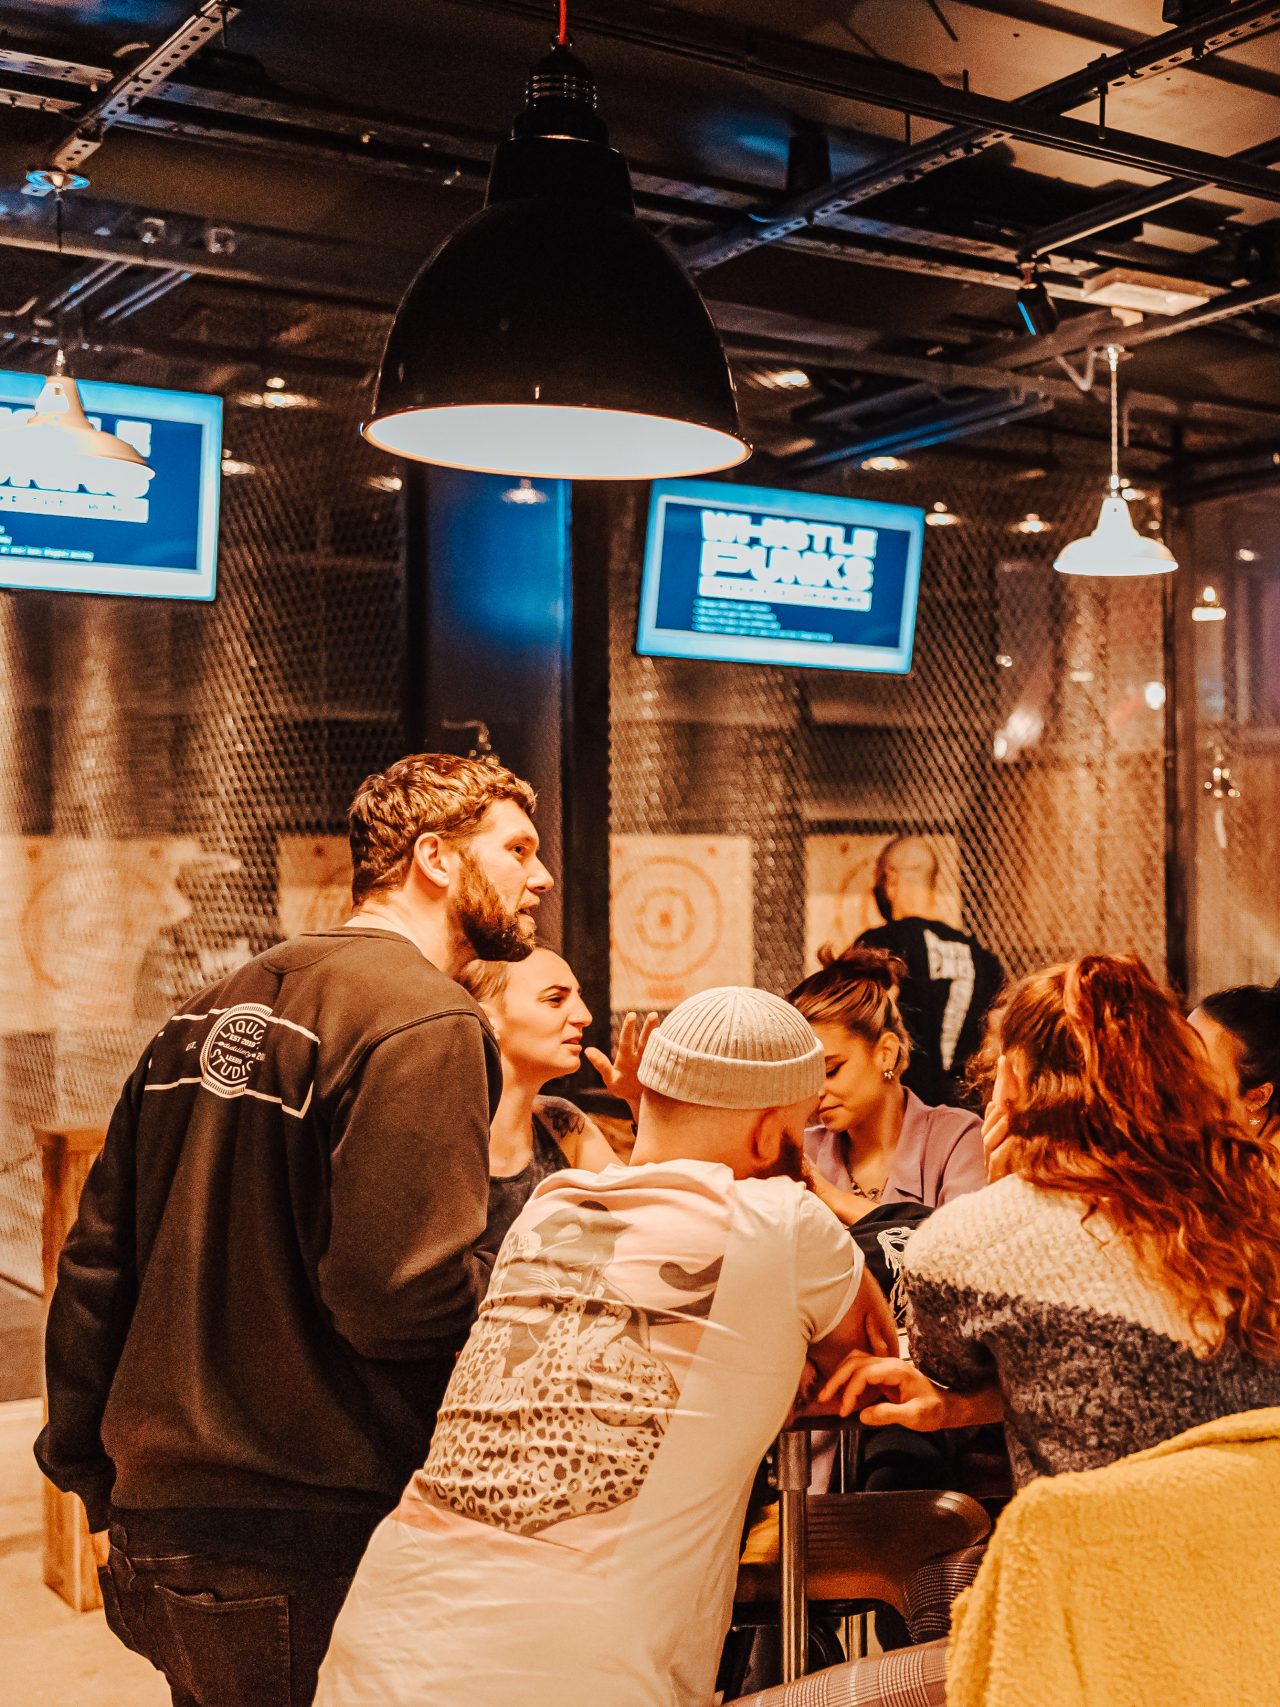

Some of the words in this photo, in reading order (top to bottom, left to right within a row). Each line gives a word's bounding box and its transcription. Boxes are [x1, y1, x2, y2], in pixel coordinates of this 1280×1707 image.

[699, 540, 875, 592] PUNKS
[219, 1020, 265, 1044] LIQUO
[229, 1033, 242, 1043] EST
[225, 1054, 243, 1065] LEEDS
